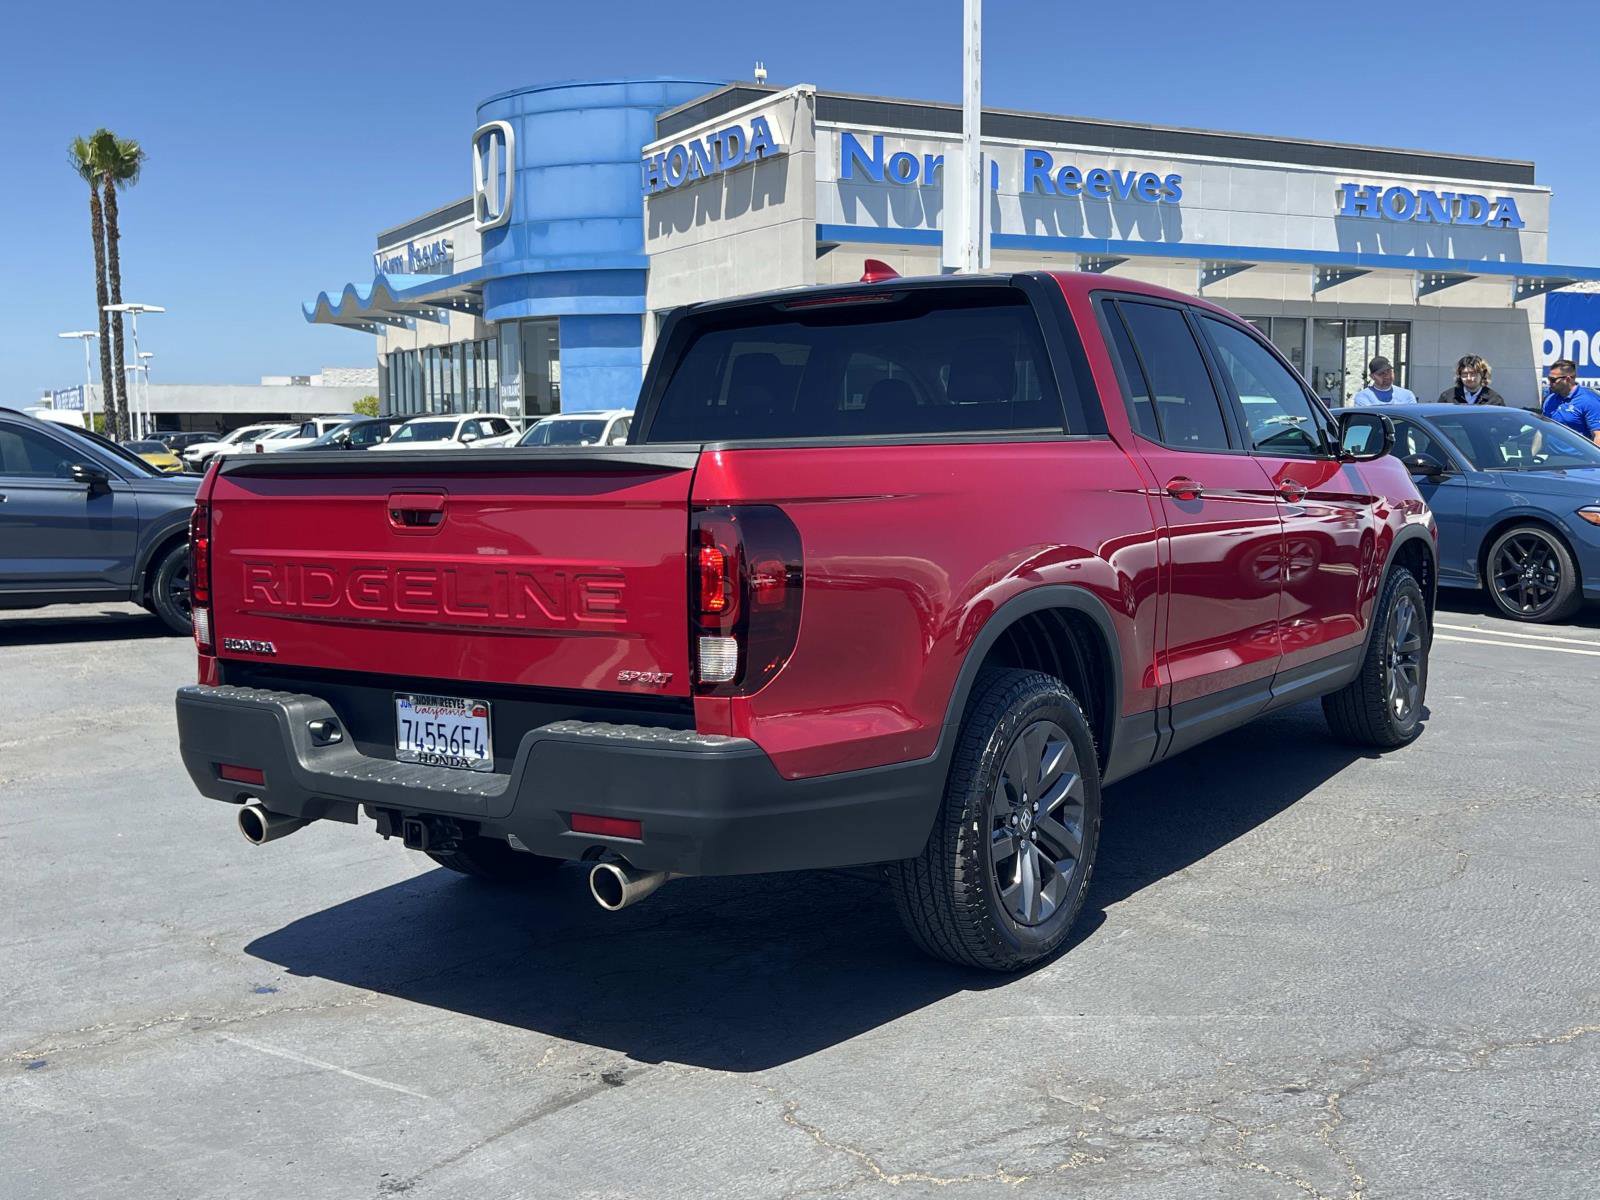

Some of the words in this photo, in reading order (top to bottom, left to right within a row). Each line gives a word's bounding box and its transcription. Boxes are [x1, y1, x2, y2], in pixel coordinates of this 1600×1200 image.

[641, 115, 780, 195] HONDA
[1024, 148, 1184, 204] Reeves
[1340, 182, 1526, 229] HONDA
[242, 560, 628, 624] RIDGELINE
[223, 637, 277, 654] HONDA
[617, 669, 673, 684] SPORT
[440, 697, 465, 709] REEVES
[402, 719, 485, 759] 74556F4
[418, 753, 470, 768] HONDA
